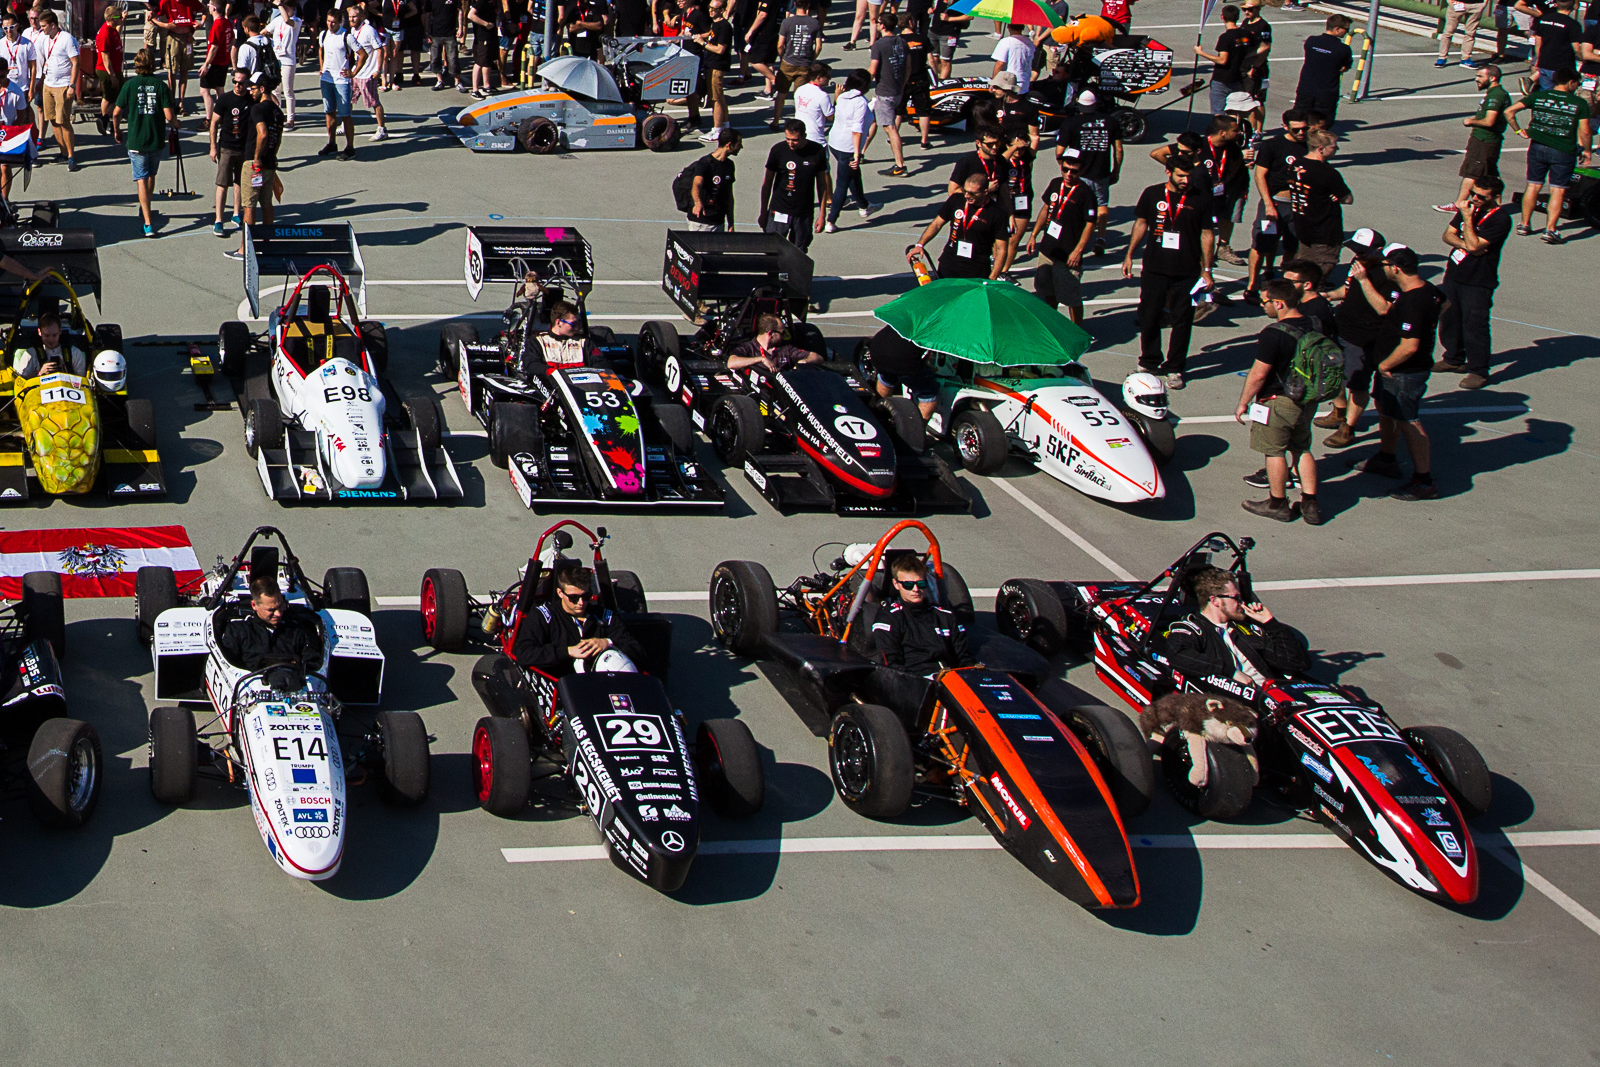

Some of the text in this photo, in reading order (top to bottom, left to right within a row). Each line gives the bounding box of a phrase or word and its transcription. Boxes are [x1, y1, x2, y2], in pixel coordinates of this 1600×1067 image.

[670, 80, 689, 94] E21
[274, 227, 323, 238] SIEMENS
[470, 254, 482, 283] 53
[669, 264, 691, 291] DENSO
[667, 362, 679, 385] 17
[44, 387, 82, 402] 110
[323, 385, 373, 403] E98
[585, 391, 621, 408] 53
[775, 371, 854, 466] UNIVERSITY OF HUDDERSFIELD
[840, 421, 867, 436] 17
[1080, 410, 1121, 427] 55
[797, 422, 811, 440] TEAM
[1046, 433, 1081, 467] SKF
[338, 489, 397, 498] SIEMENS
[605, 718, 662, 746] 29
[272, 737, 329, 761] E14
[569, 716, 623, 804] UAS KECSKEMÉT
[1355, 754, 1394, 787] AMK
[574, 761, 601, 817] 29
[299, 797, 331, 805] BOSCH
[990, 776, 1029, 827] MOTUL
[274, 798, 290, 828] ZOLTEK
[297, 812, 313, 821] AVL
[332, 806, 342, 838] ZOLTEK
